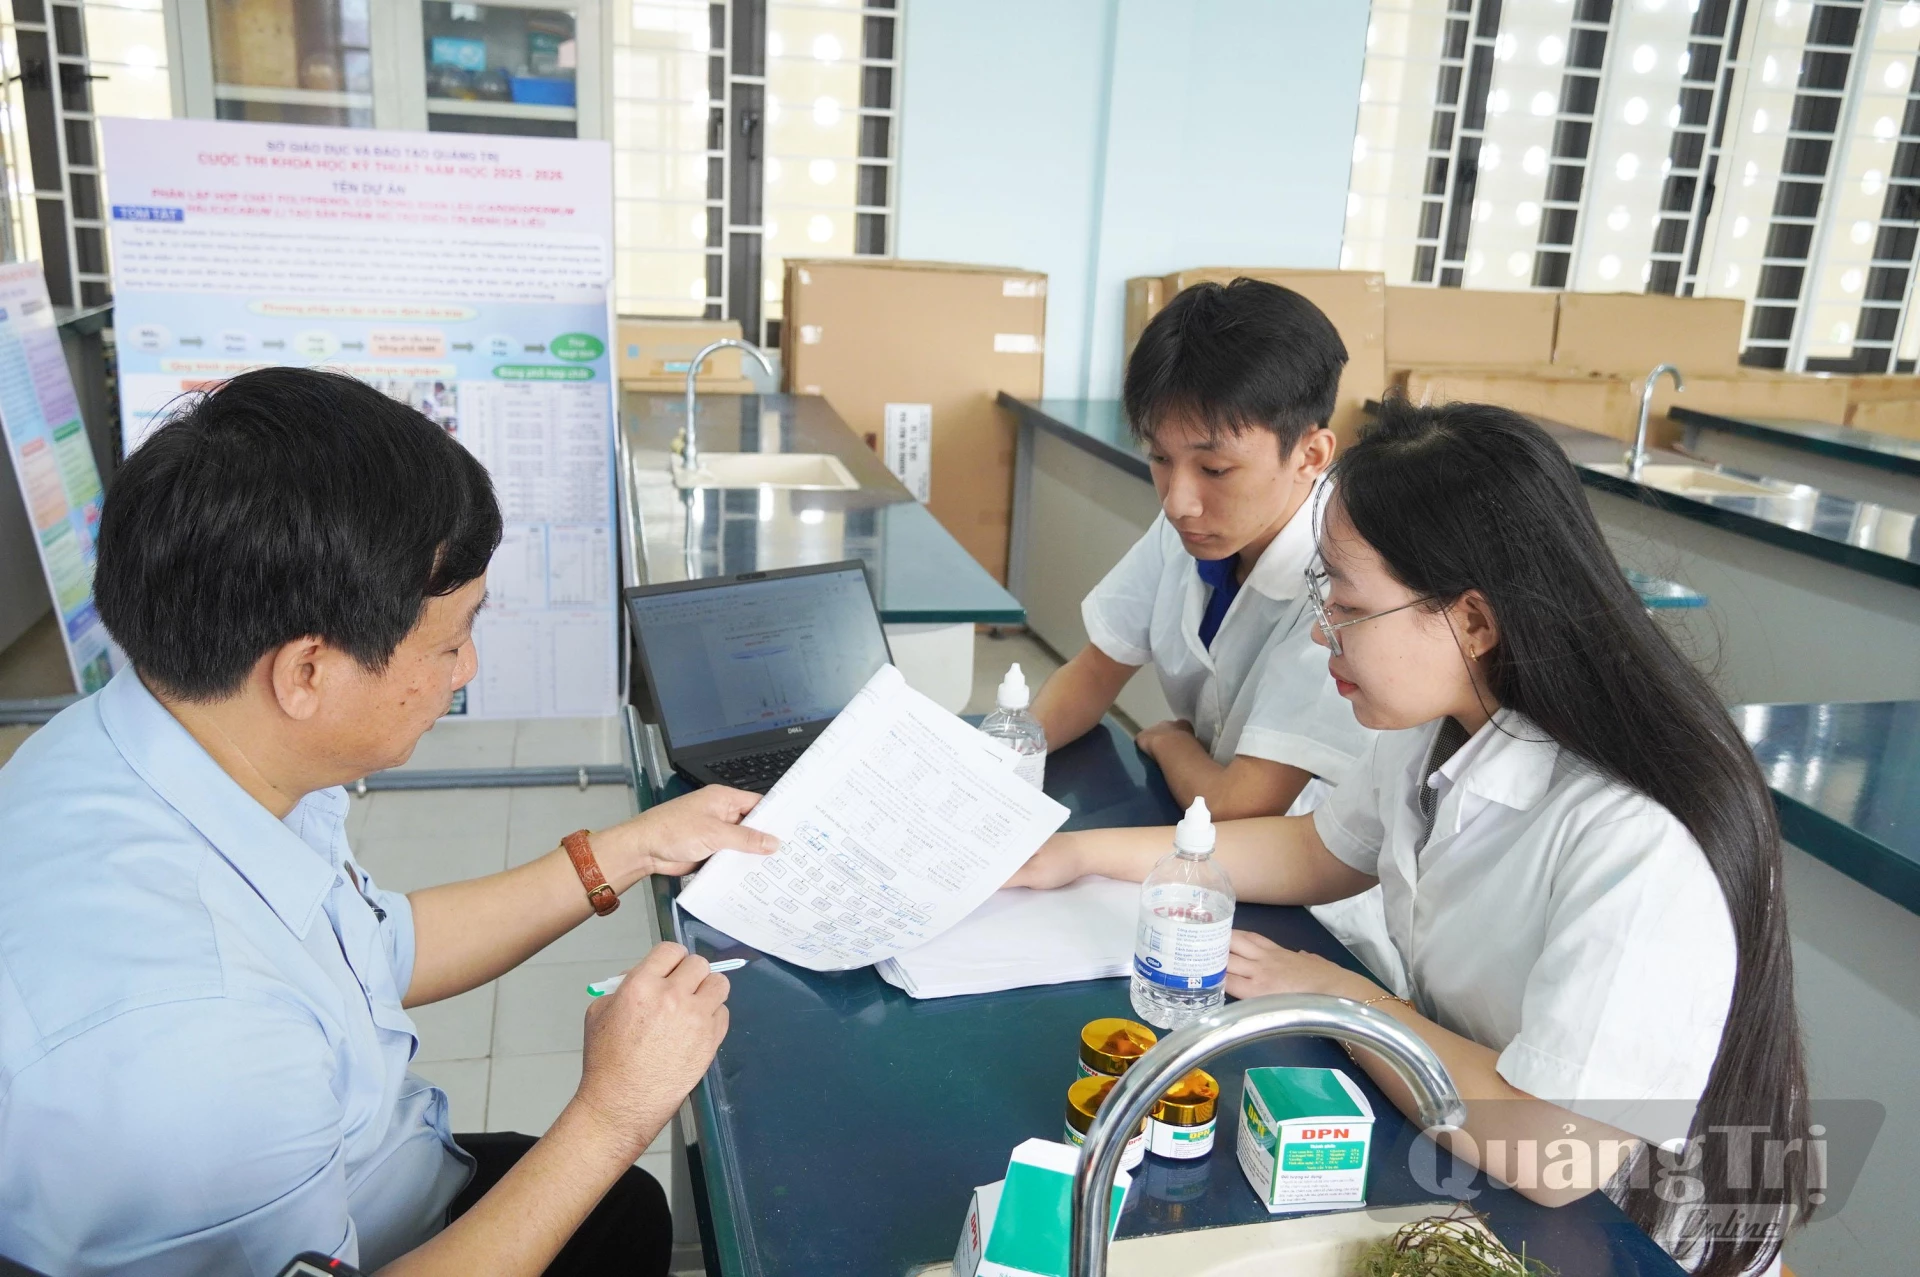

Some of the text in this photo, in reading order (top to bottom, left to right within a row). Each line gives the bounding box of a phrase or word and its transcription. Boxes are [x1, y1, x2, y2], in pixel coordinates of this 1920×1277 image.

[432, 149, 476, 162] QUẢNG
[480, 152, 500, 163] TRỊ
[198, 152, 564, 181] CUỘC THI KHOA HỌC KỸ THUẬT NĂM HỌC 2025 2026
[332, 180, 406, 195] TÊN DỰ ÁN
[788, 726, 803, 734] DELL
[1082, 1064, 1098, 1077] DPN
[1248, 1103, 1265, 1139] DPN
[1190, 1128, 1210, 1139] DPN
[1302, 1128, 1350, 1140] DPN
[1128, 1136, 1142, 1146] DPN
[970, 1211, 978, 1252] DPN
